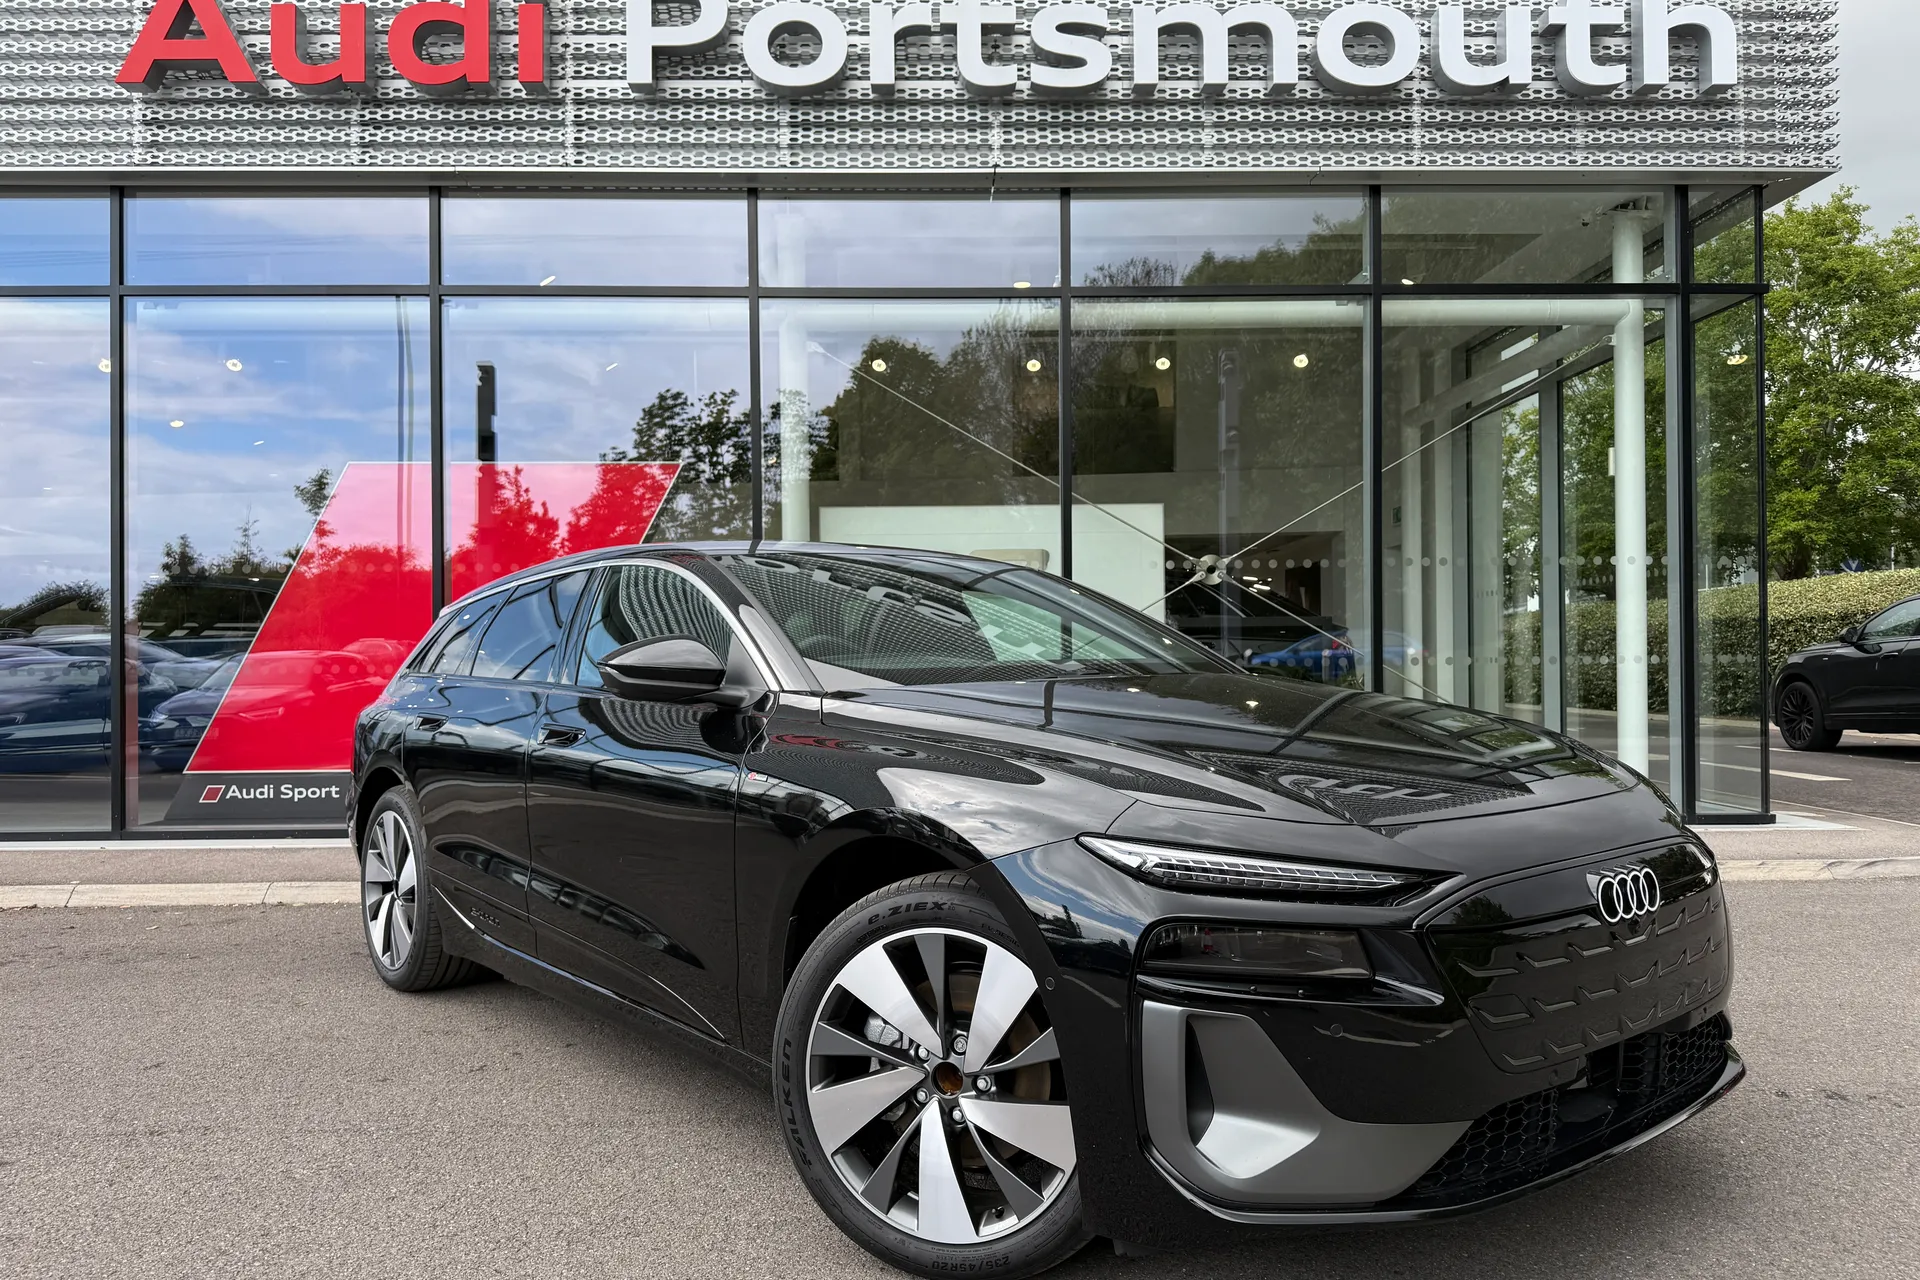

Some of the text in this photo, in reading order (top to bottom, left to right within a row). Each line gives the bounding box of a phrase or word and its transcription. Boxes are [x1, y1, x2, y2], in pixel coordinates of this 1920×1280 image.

[115, 0, 1738, 94] Audi Portsmouth
[225, 784, 340, 802] Audi Sport
[781, 1037, 812, 1172] FALKEN
[931, 1255, 1010, 1272] 235/45R20
